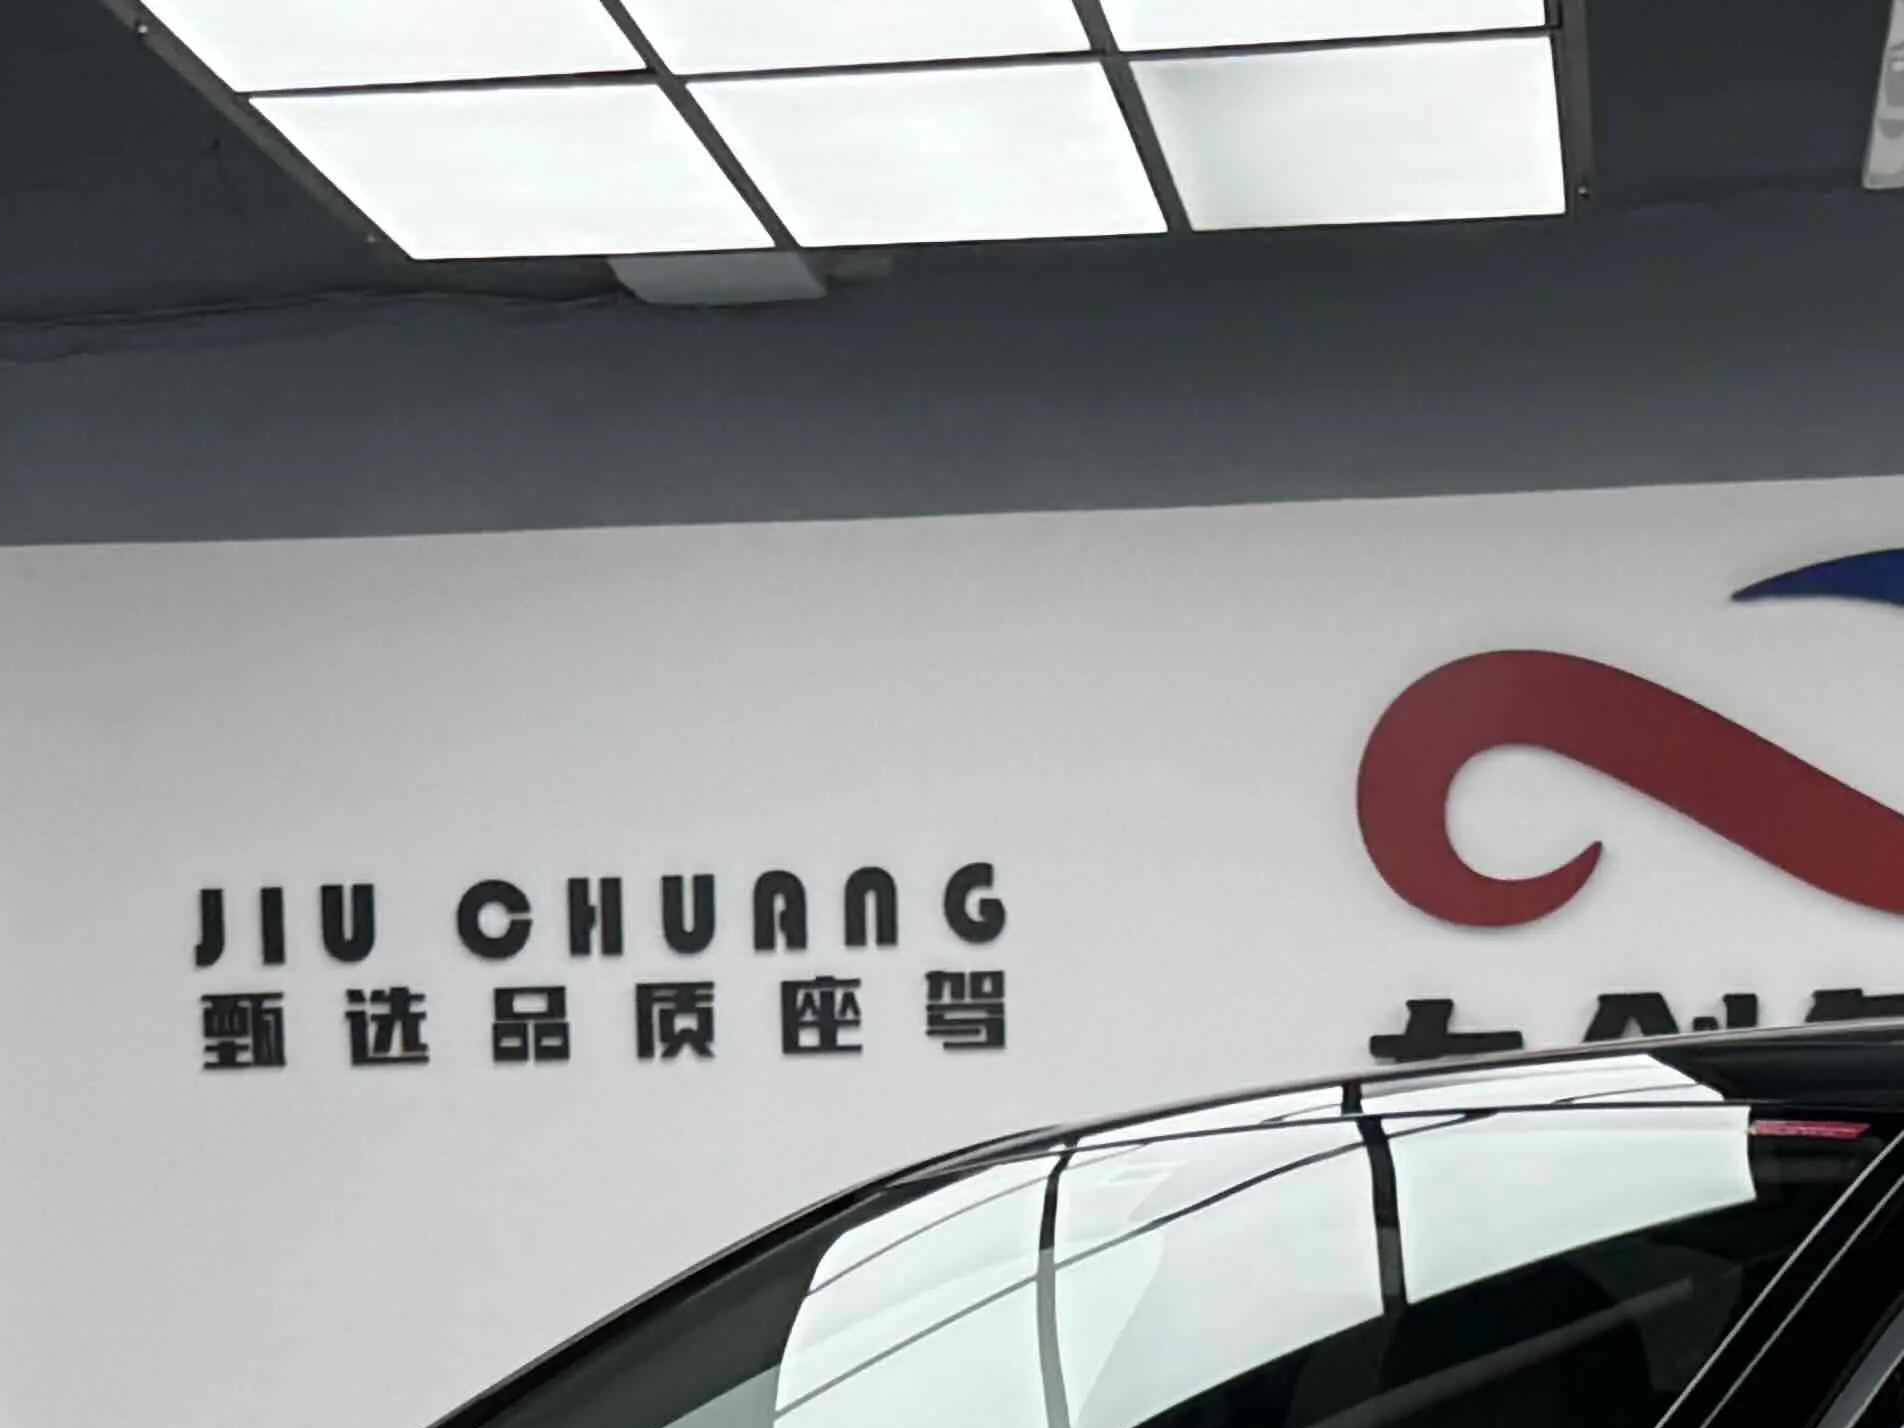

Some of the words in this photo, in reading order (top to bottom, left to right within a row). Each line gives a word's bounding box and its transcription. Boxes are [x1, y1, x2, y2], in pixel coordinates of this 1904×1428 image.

[194, 884, 376, 968] JIU
[457, 863, 1007, 961] CHUANG
[201, 970, 1007, 1071] 甄选品质座驾
